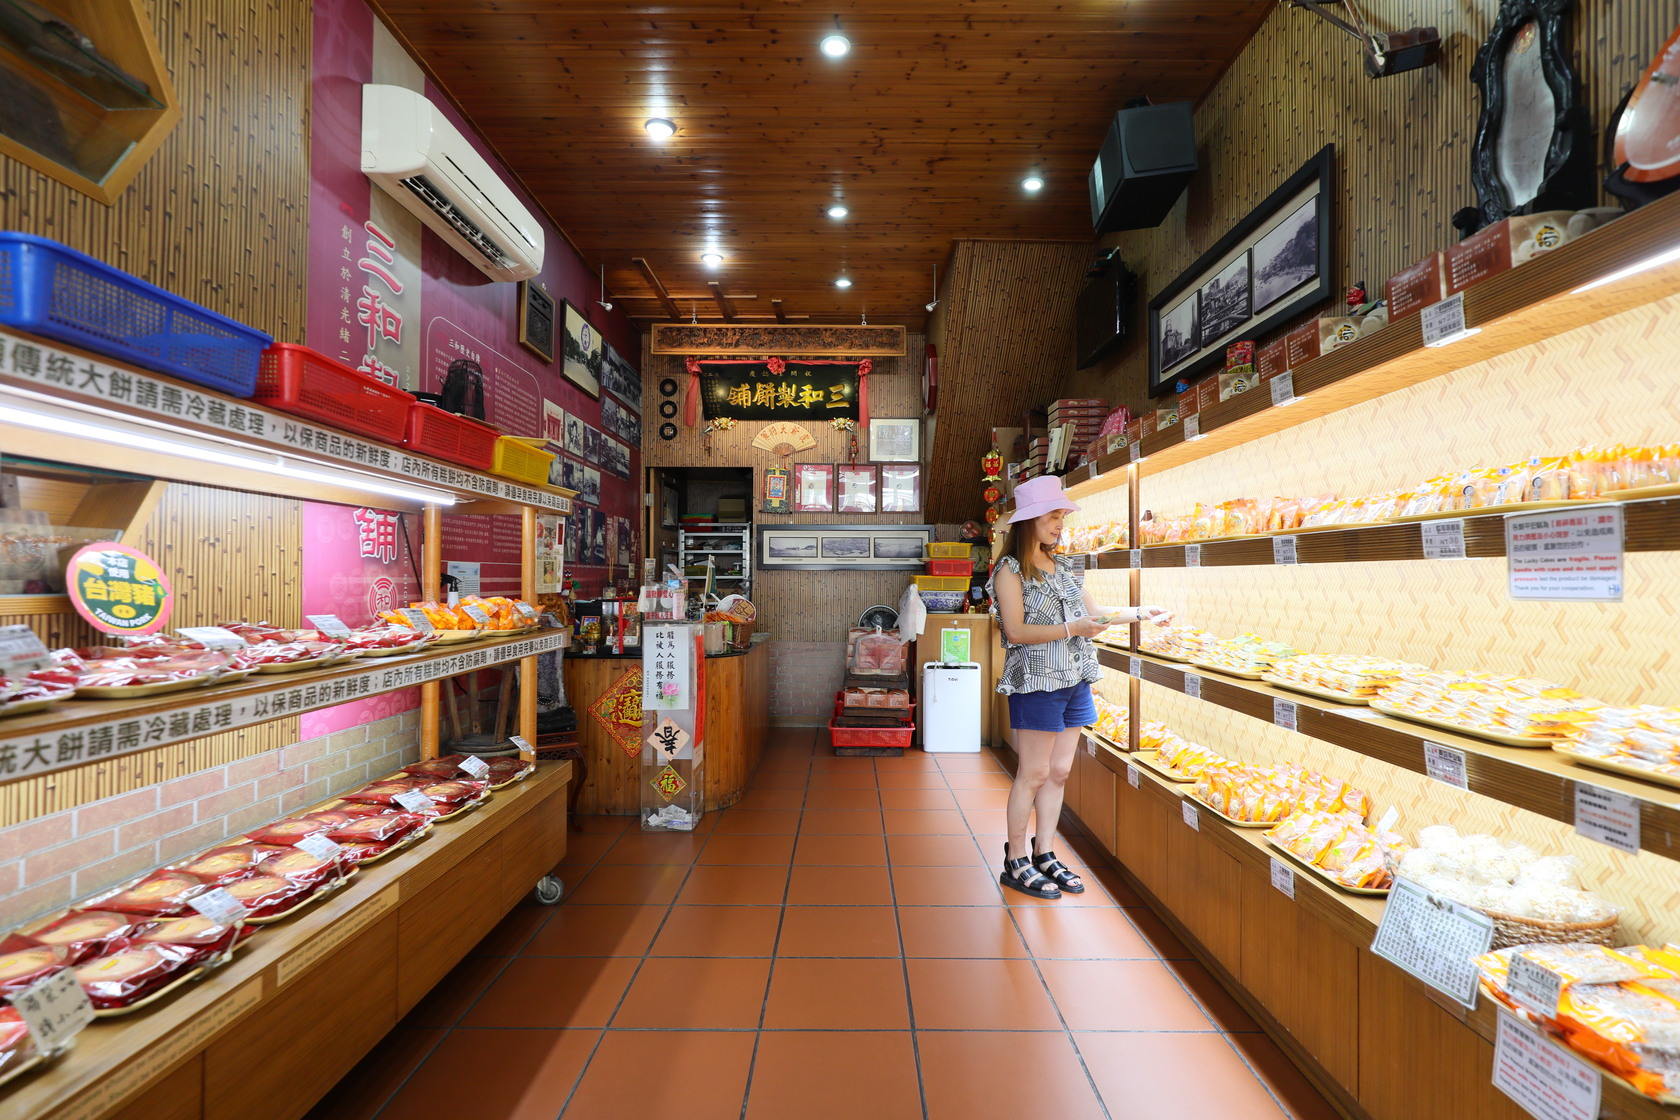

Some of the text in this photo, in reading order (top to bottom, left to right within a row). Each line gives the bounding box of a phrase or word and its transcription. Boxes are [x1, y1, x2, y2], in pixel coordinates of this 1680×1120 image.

[339, 225, 353, 362] 創立於清光緒二
[353, 507, 400, 564] 舖
[83, 577, 156, 606] 台灣豬
[95, 607, 153, 627] TAIWAN PORK
[660, 775, 677, 793] 福
